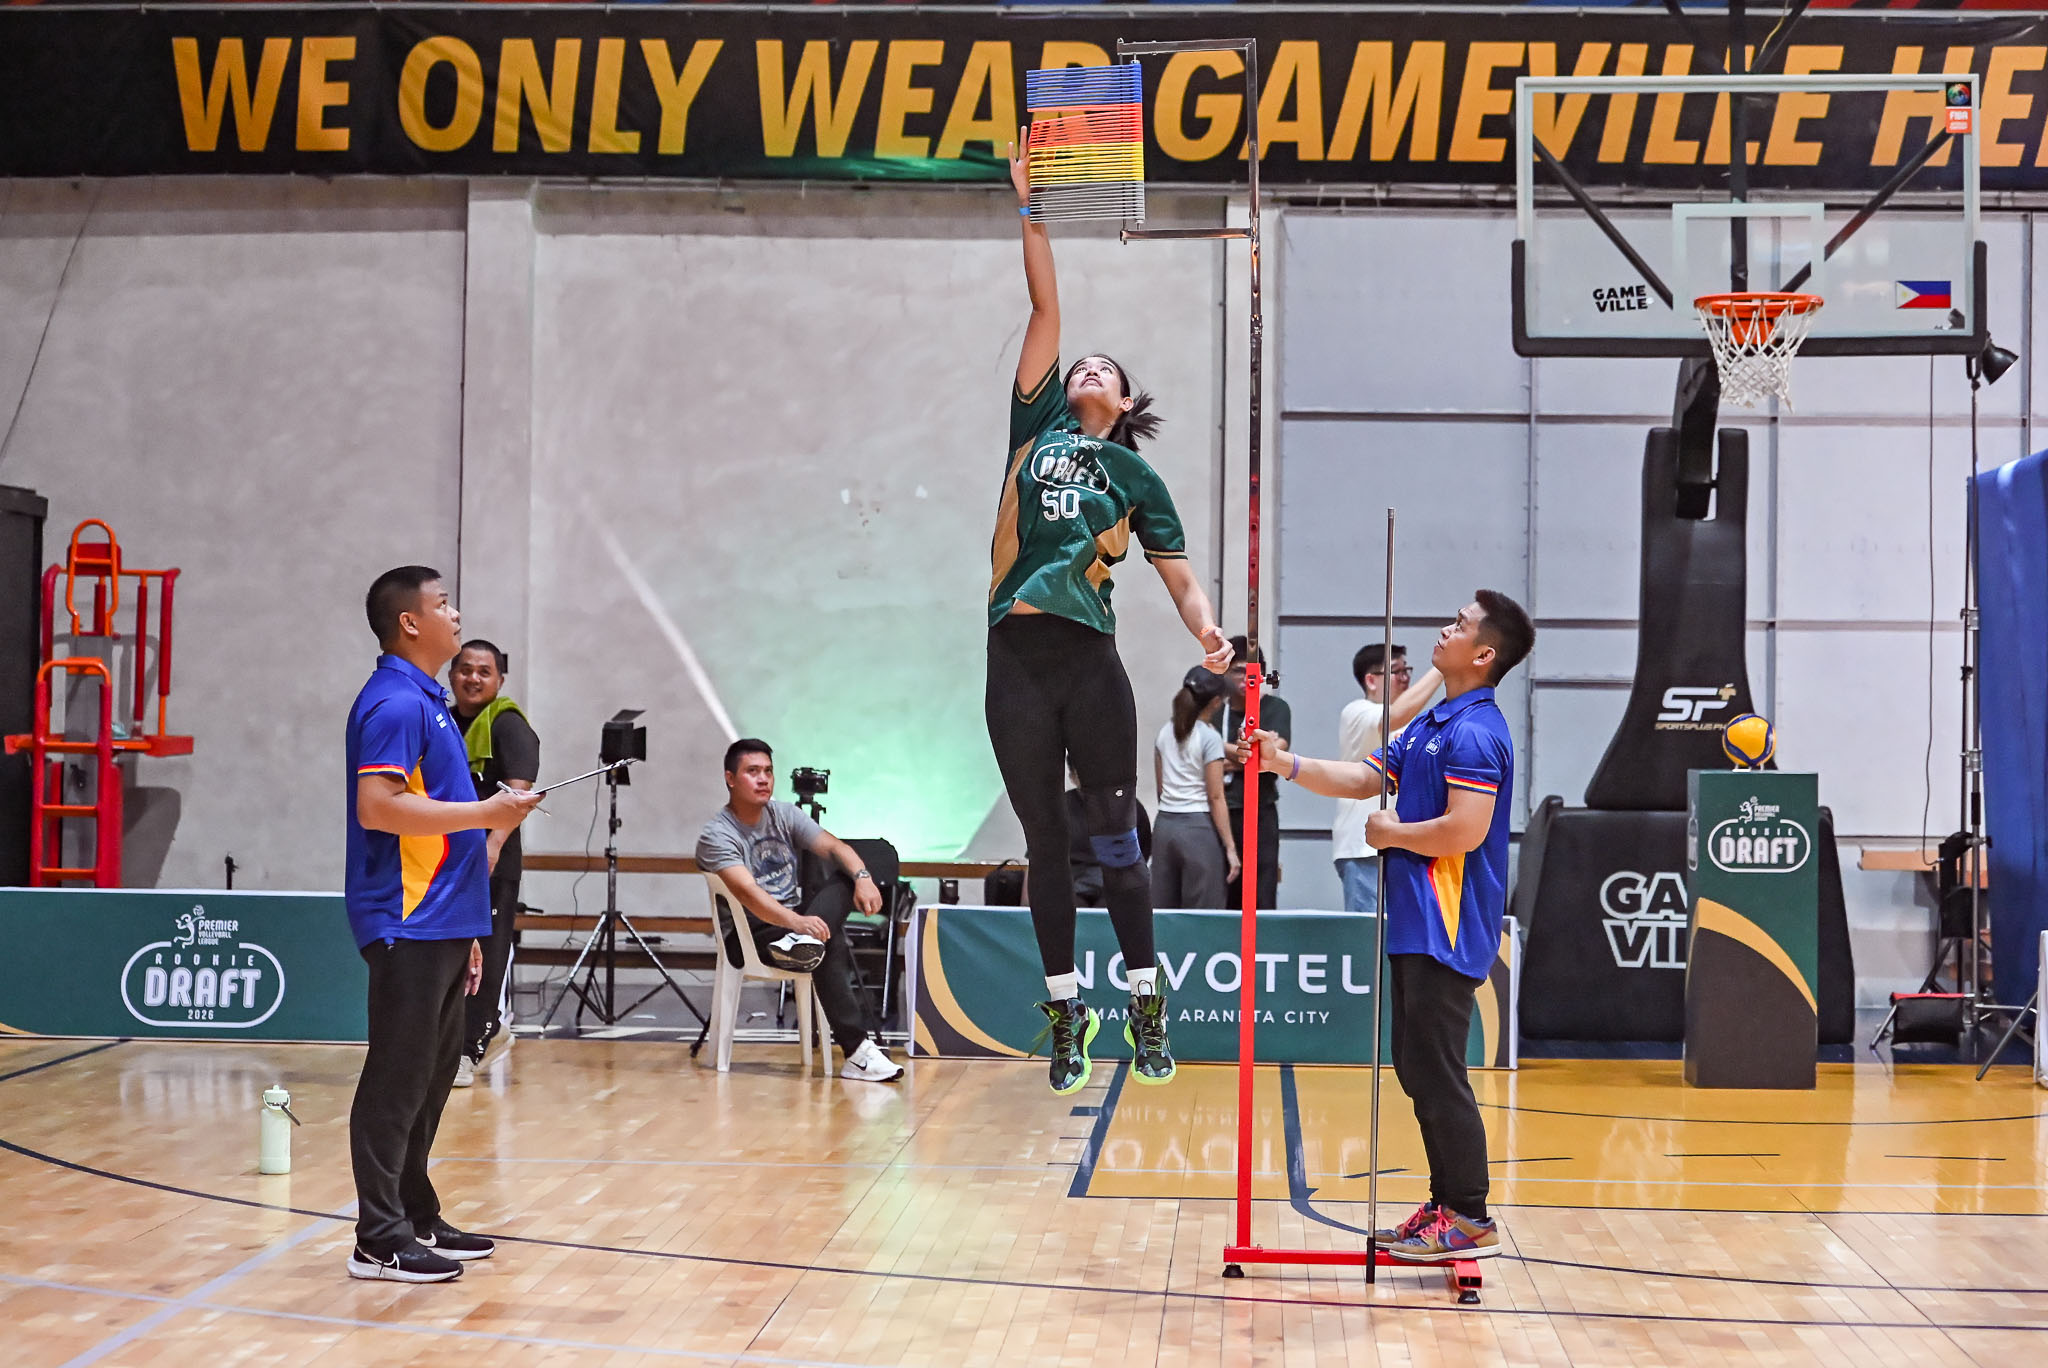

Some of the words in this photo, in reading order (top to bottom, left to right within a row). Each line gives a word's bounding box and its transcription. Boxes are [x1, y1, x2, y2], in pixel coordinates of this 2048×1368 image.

[173, 37, 357, 151] WE
[399, 36, 724, 154] ONLY
[1870, 46, 2048, 167] HE
[1592, 285, 1646, 300] GAME
[1595, 298, 1648, 312] VILLE
[1041, 488, 1081, 521] 50
[1719, 836, 1799, 865] DRAFT
[198, 919, 239, 932] PREMIER
[155, 953, 254, 966] ROOKIE
[144, 966, 262, 1009] DRAFT
[188, 1009, 214, 1020] 2026
[1284, 1011, 1330, 1024] CITY
